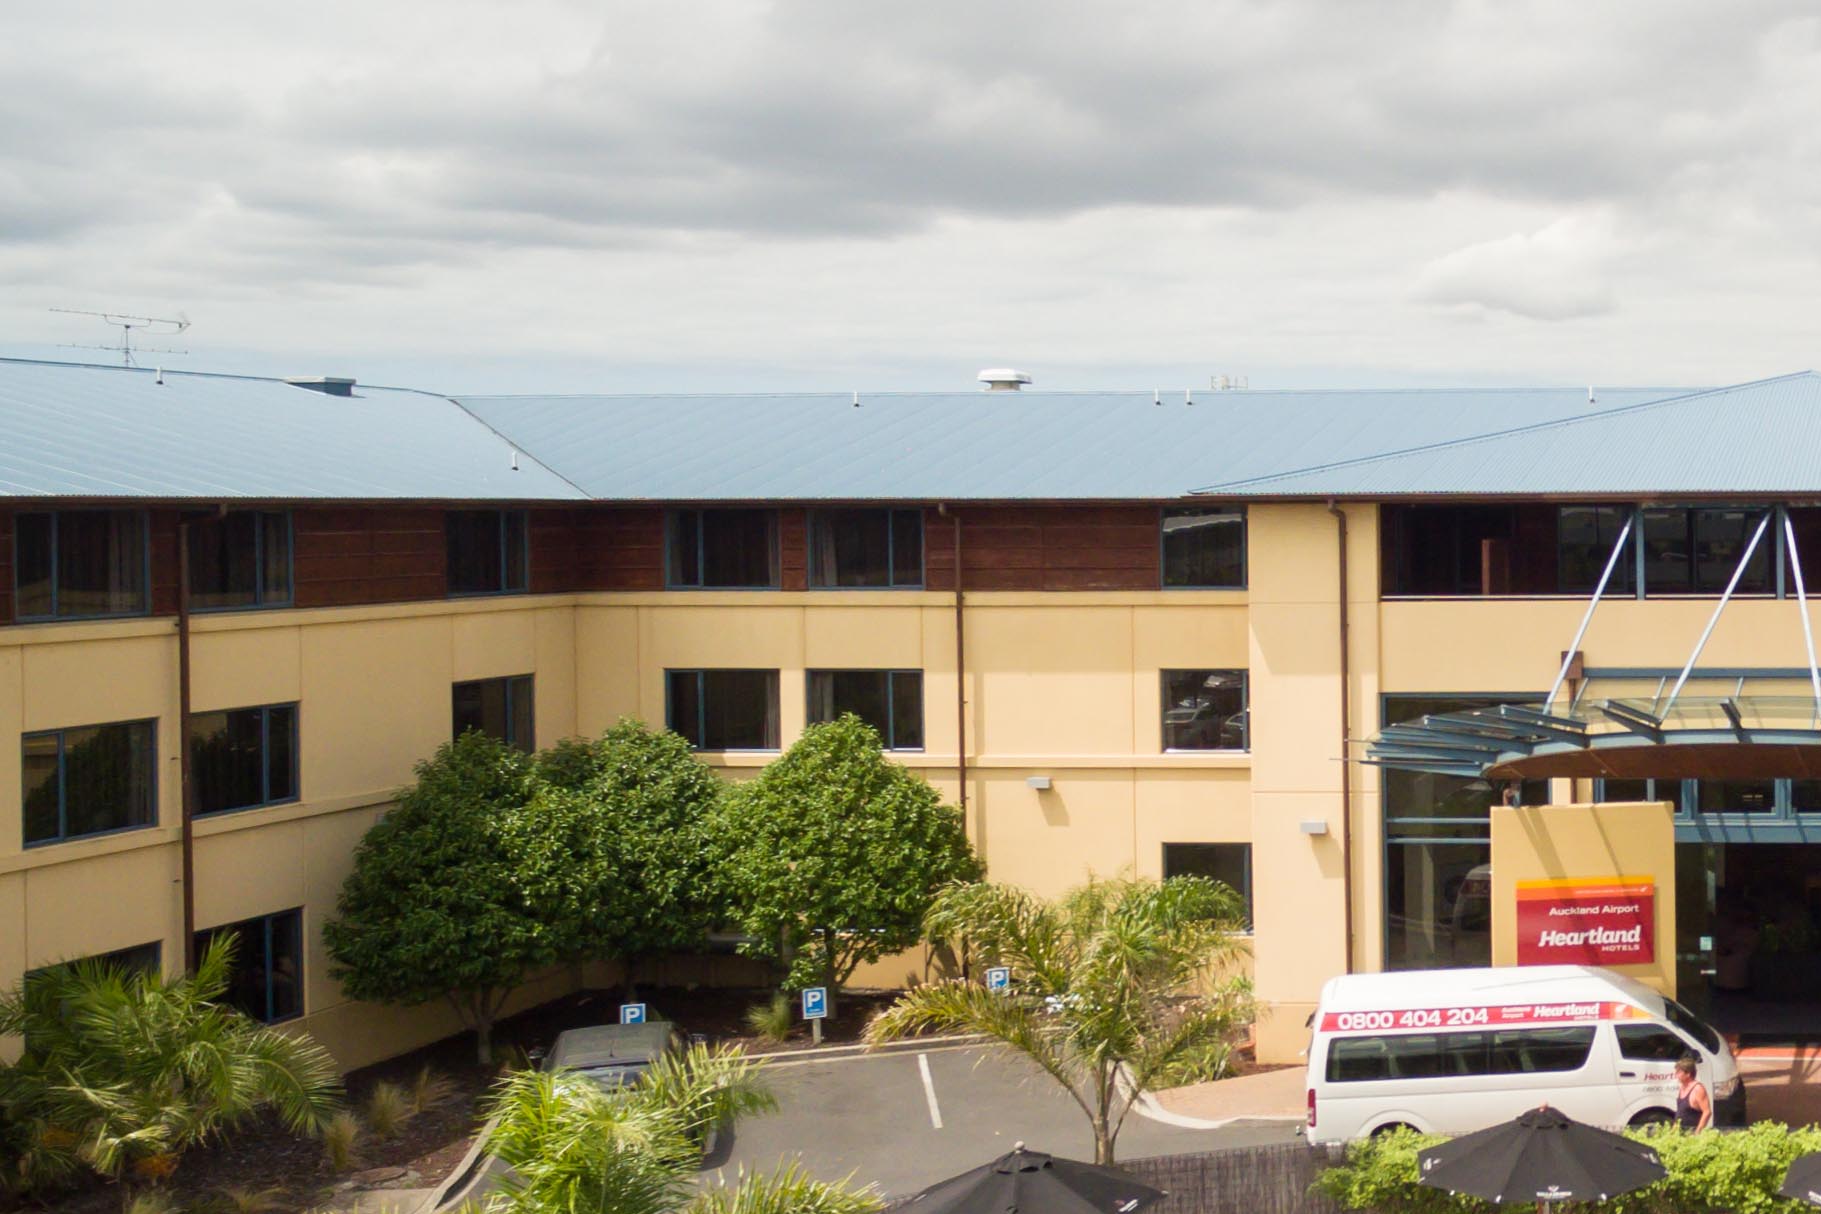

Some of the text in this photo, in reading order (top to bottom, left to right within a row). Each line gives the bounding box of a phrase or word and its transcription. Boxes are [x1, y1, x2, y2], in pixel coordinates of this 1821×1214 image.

[1549, 904, 1639, 916] Auckland Airport
[1538, 925, 1641, 946] Heartland
[1601, 944, 1640, 952] HOTELS
[808, 992, 821, 1007] P
[626, 1008, 640, 1024] P
[1533, 1003, 1600, 1018] Heartland
[1338, 1008, 1488, 1029] 0800 404 204
